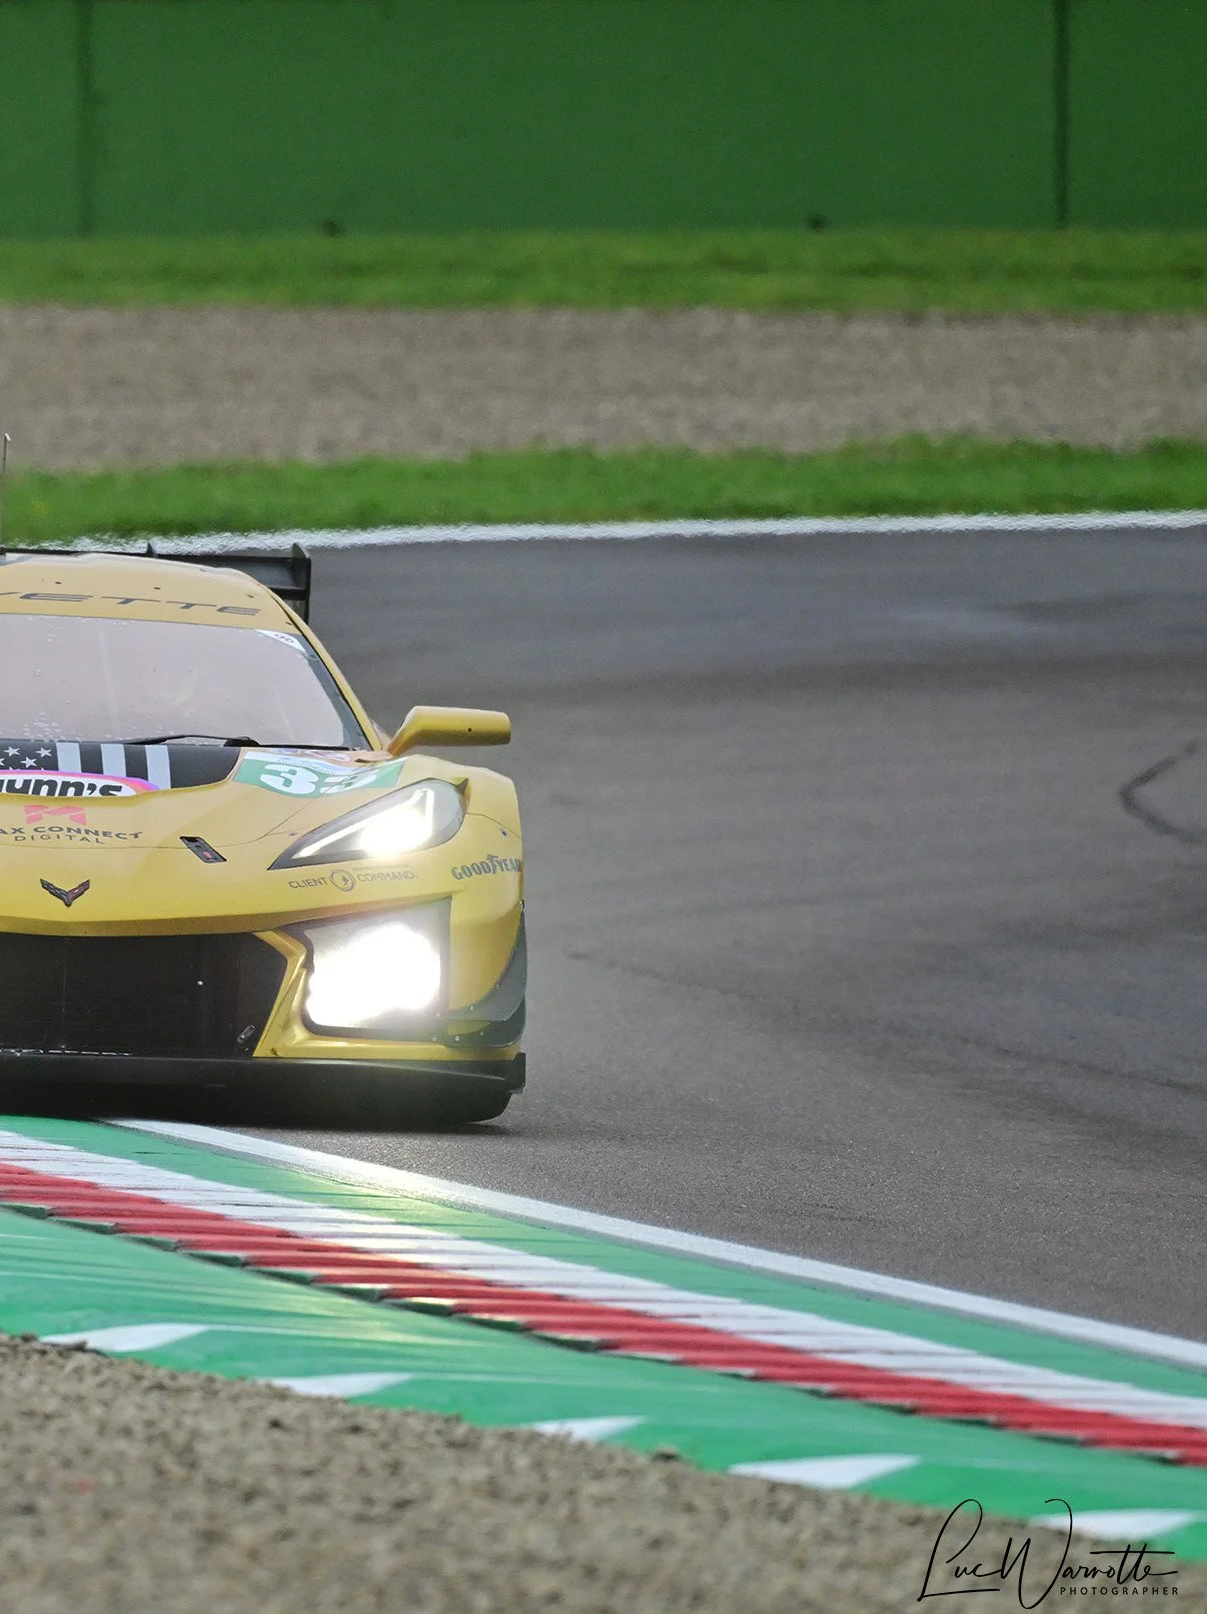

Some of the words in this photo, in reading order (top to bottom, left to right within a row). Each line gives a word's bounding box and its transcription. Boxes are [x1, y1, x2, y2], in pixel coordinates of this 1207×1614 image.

[14, 834, 106, 845] DIGITAL
[33, 826, 144, 841] CONNECT
[288, 877, 327, 889] CLIENT
